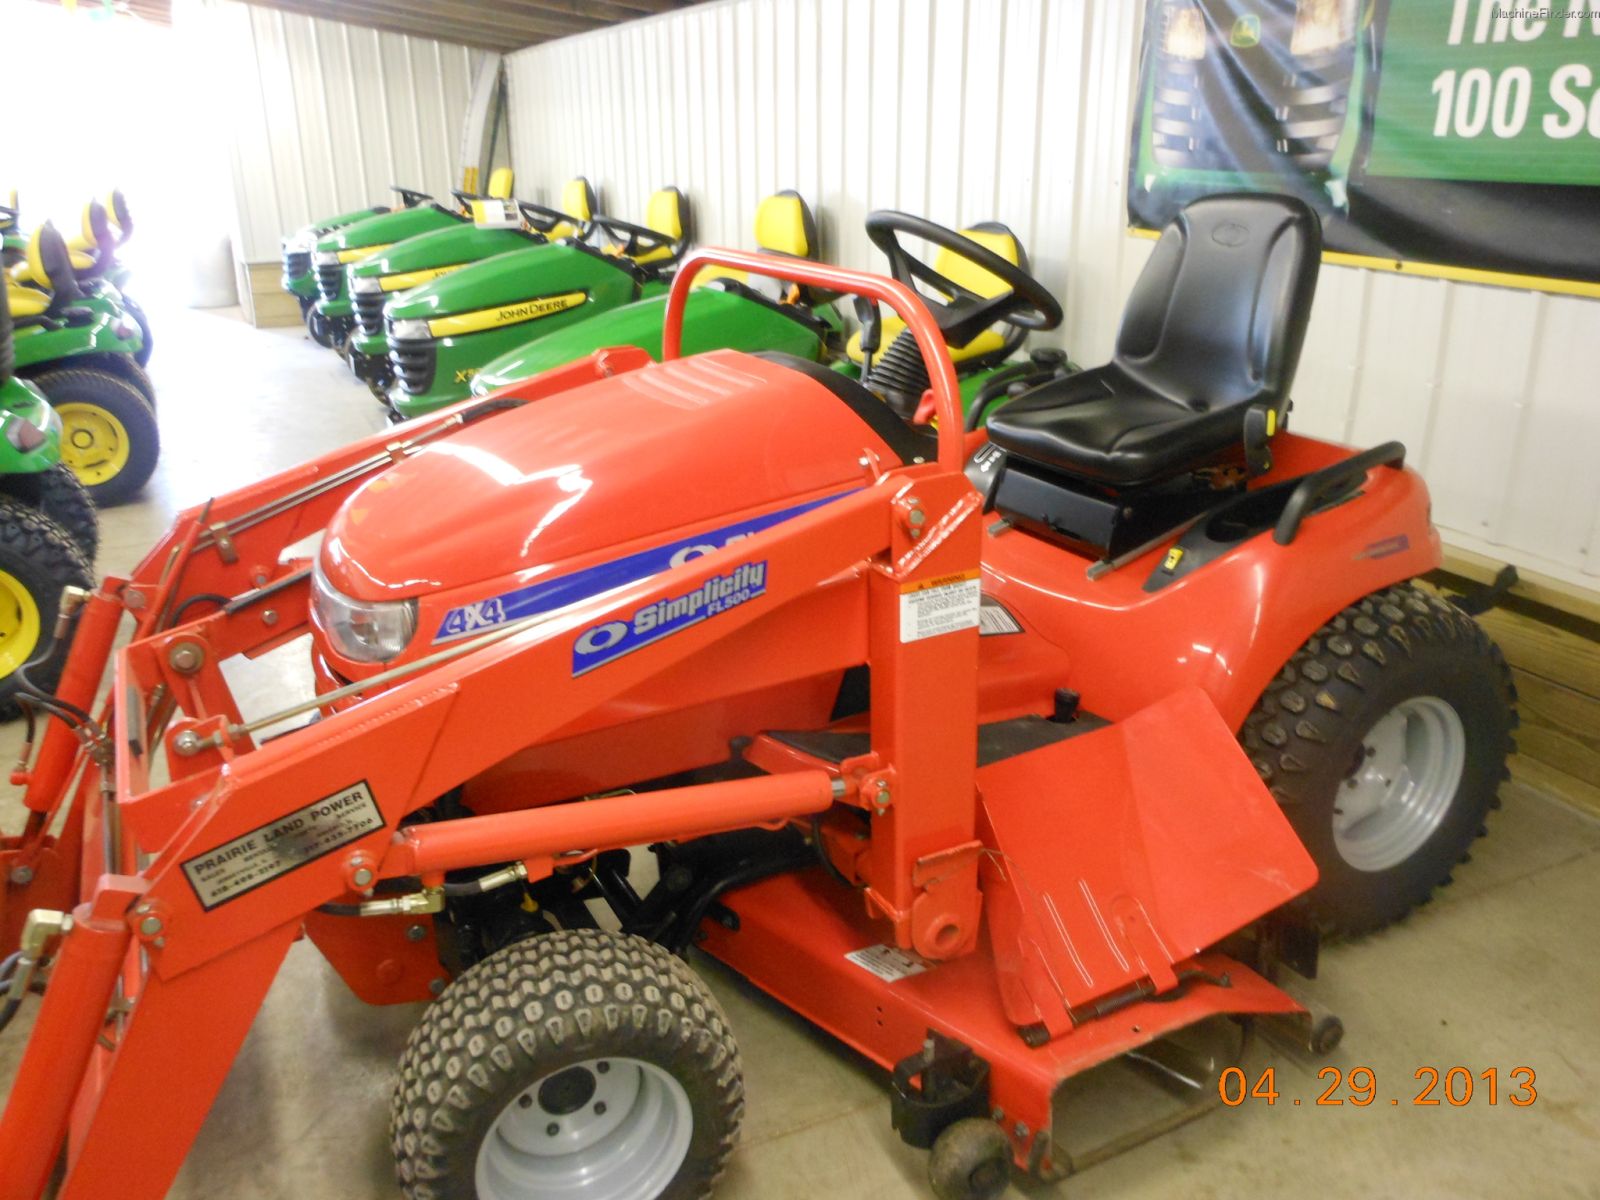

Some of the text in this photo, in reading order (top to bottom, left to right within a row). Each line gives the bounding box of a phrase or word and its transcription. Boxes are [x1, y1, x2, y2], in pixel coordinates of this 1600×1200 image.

[1431, 65, 1532, 139] 100
[496, 298, 568, 322] JOHN DEERE
[633, 562, 766, 635] Simplicity
[707, 588, 751, 616] FL500
[193, 839, 257, 875] PRAIRIE
[262, 817, 305, 843] LAND
[309, 790, 363, 821] POWER
